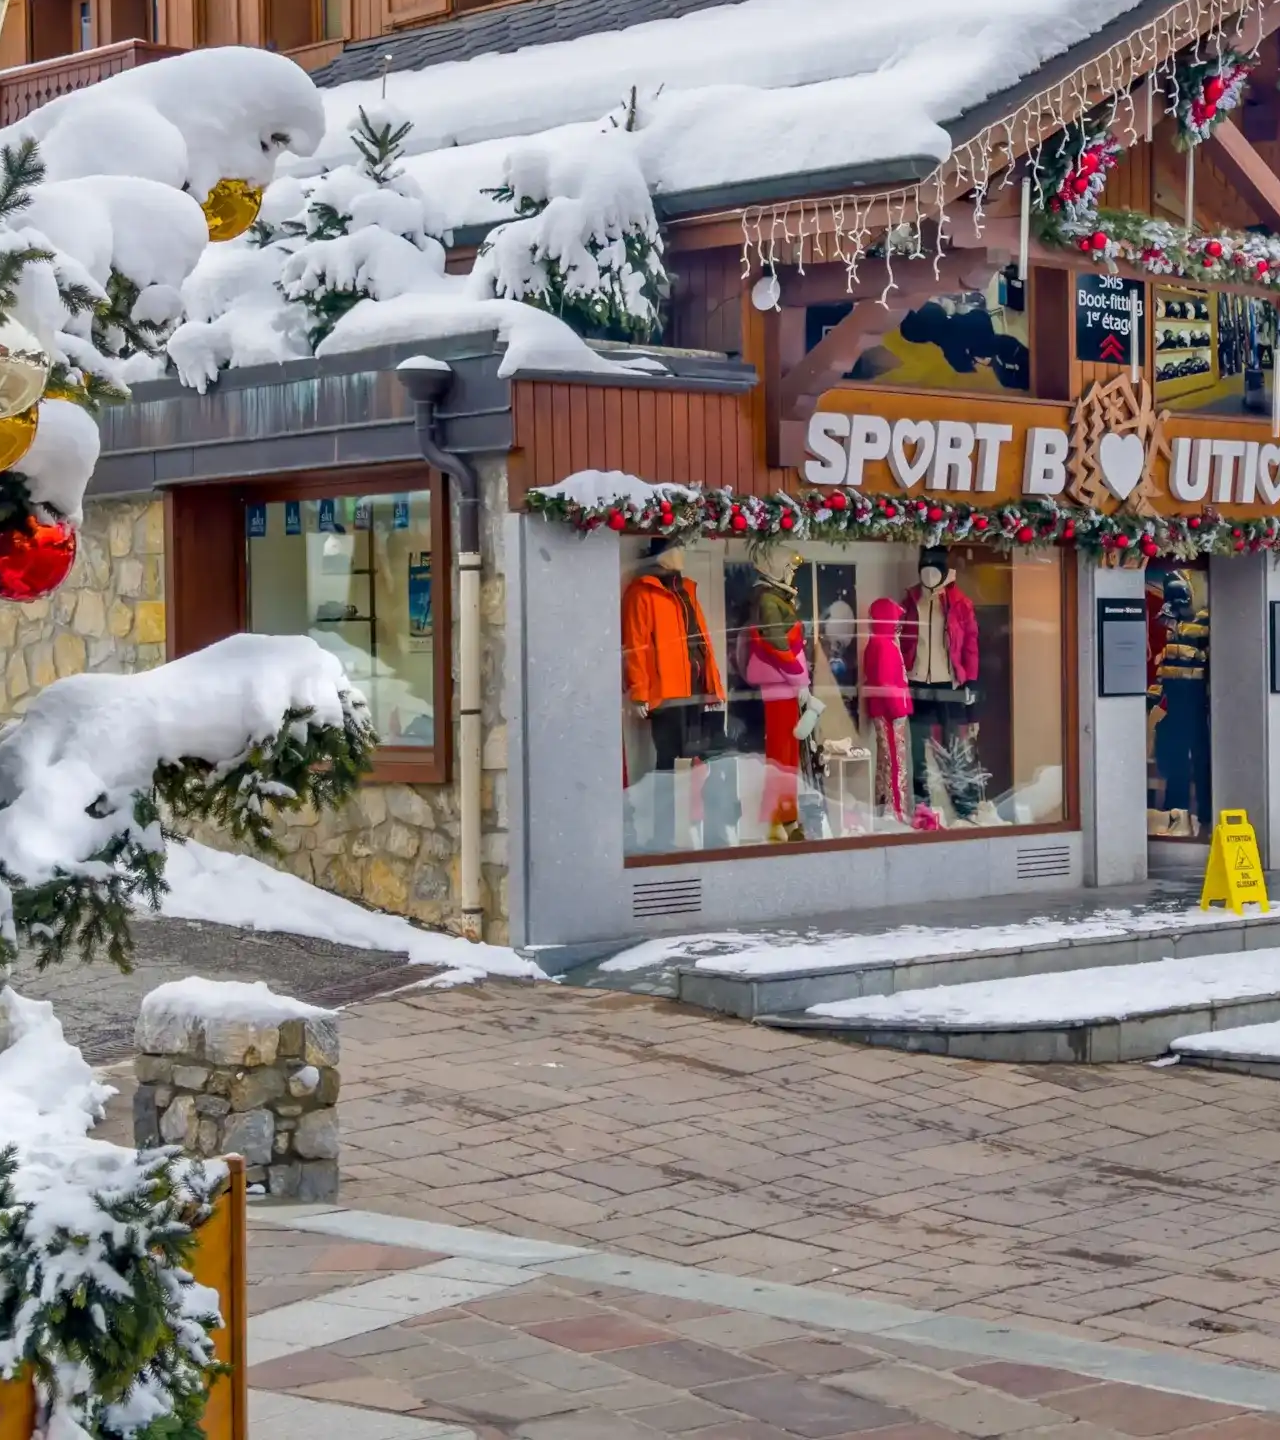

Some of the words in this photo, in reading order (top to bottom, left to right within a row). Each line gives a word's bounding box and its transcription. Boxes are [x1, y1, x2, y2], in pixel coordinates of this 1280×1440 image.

[1099, 274, 1124, 290] Skis
[1078, 289, 1144, 317] Boot-fittig
[801, 411, 1013, 492] SPORT
